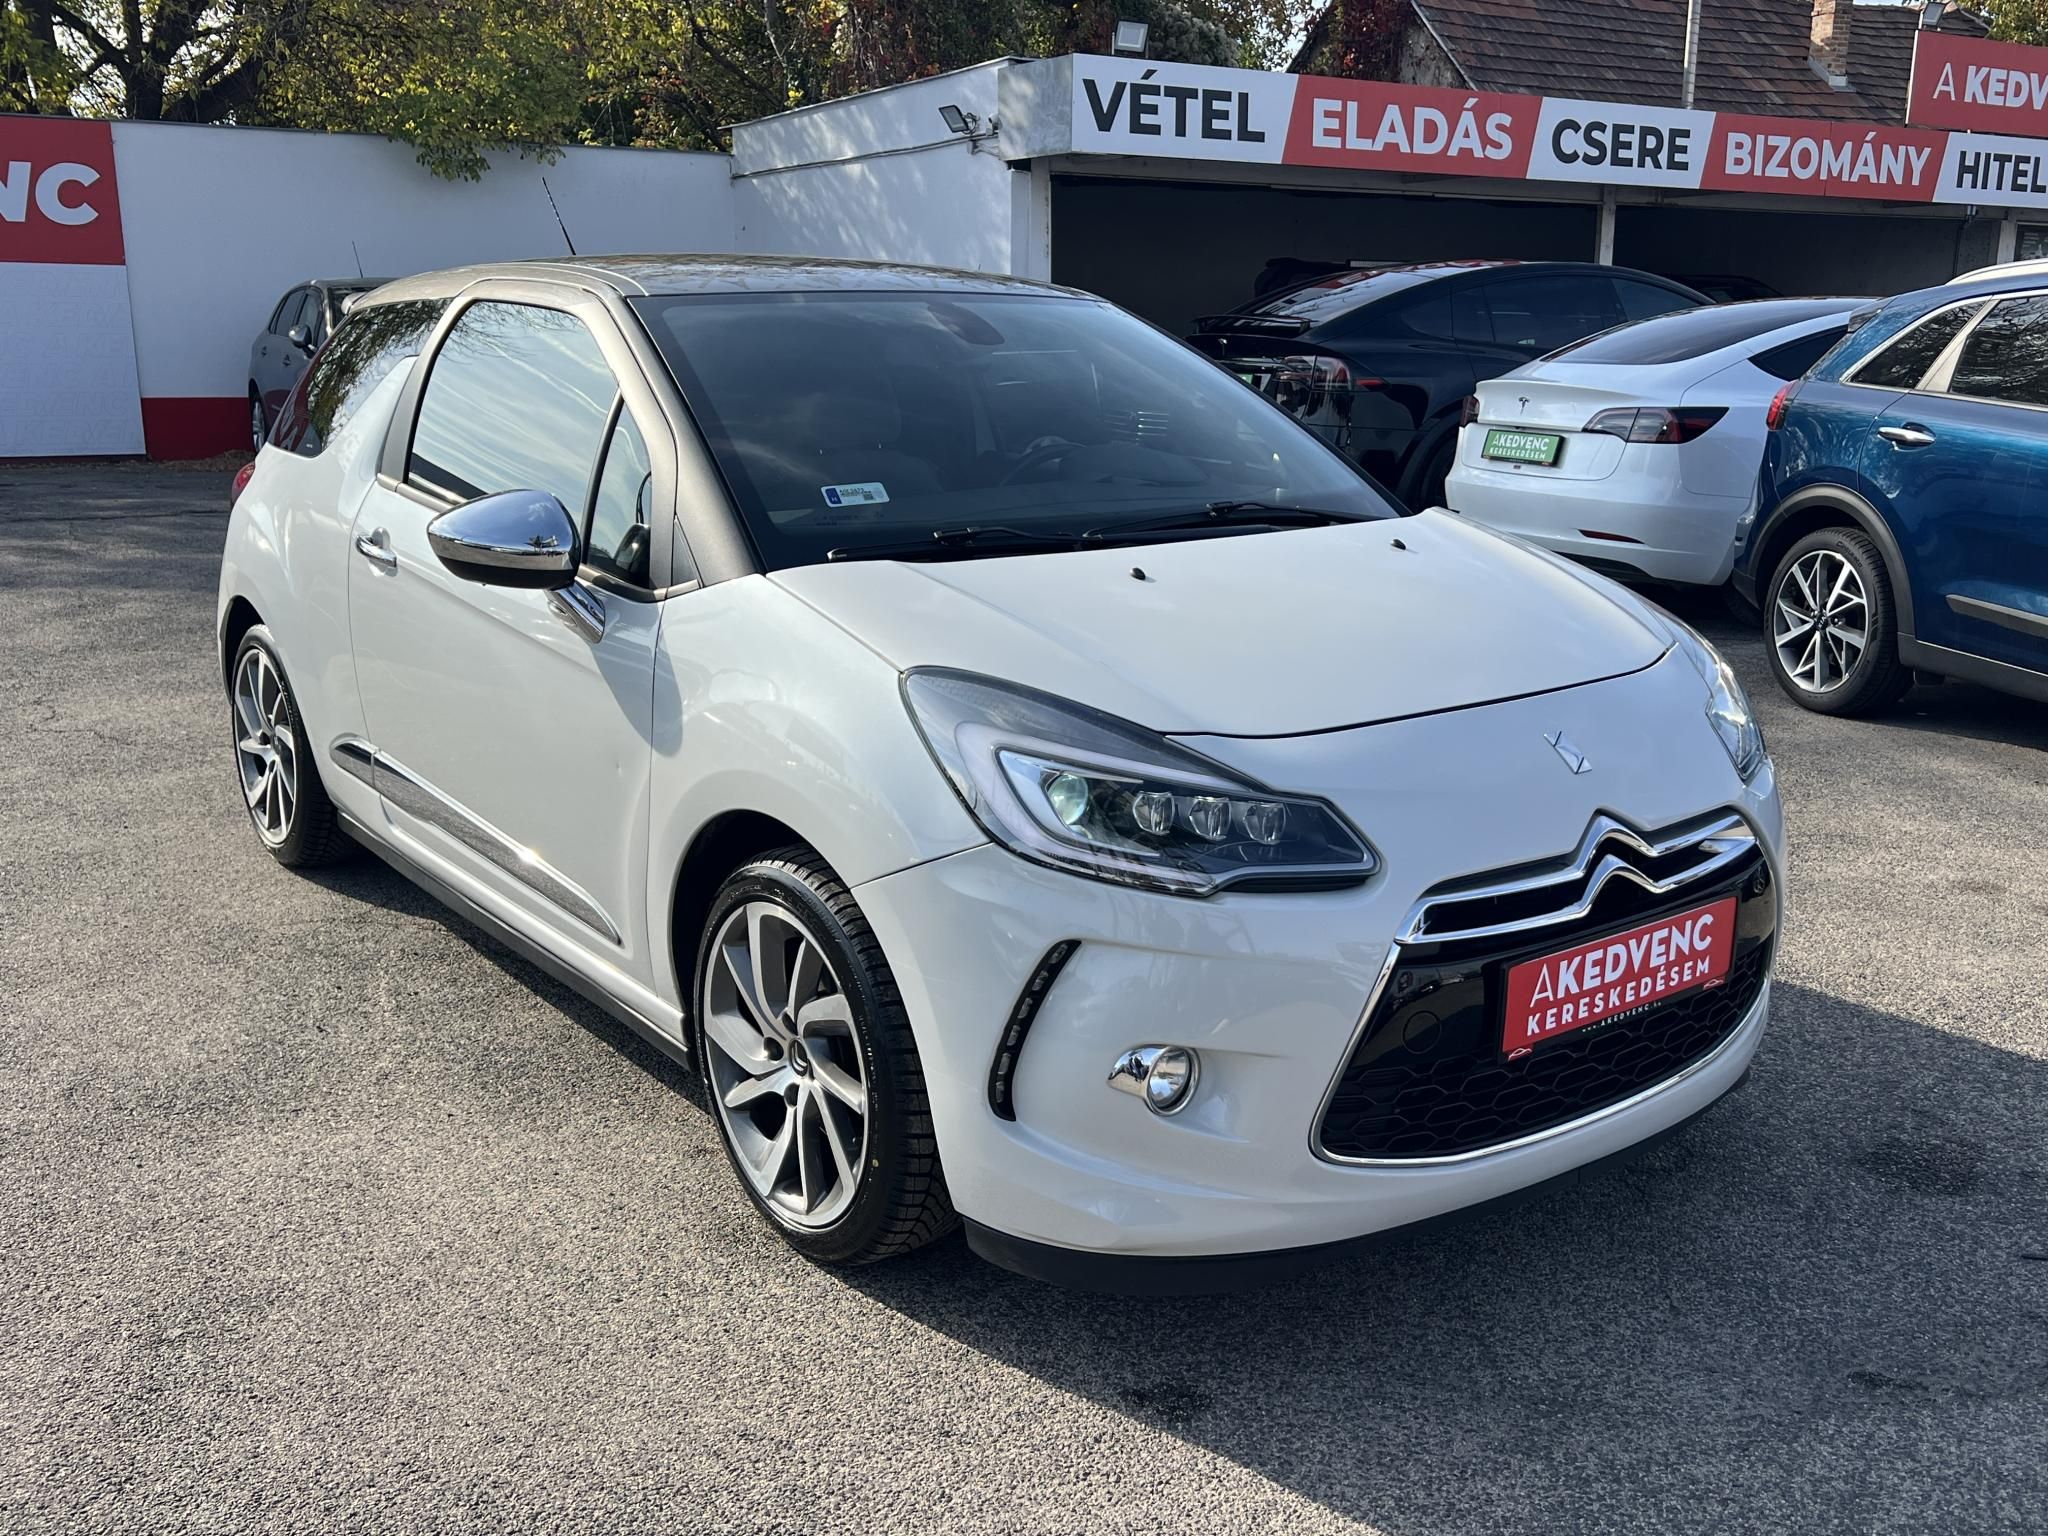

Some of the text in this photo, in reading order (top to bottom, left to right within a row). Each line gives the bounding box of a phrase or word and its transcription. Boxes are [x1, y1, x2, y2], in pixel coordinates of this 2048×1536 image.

[1082, 69, 1266, 143] VÉTEL
[1932, 62, 2048, 111] A KEDV
[1312, 98, 1513, 161] ELADÁS
[1551, 118, 1691, 171] CSERE
[1725, 131, 1932, 187] BIZOMÁNY
[1956, 150, 2047, 194] HITEL
[1526, 955, 1710, 1037] KERESKEDÉSEM
